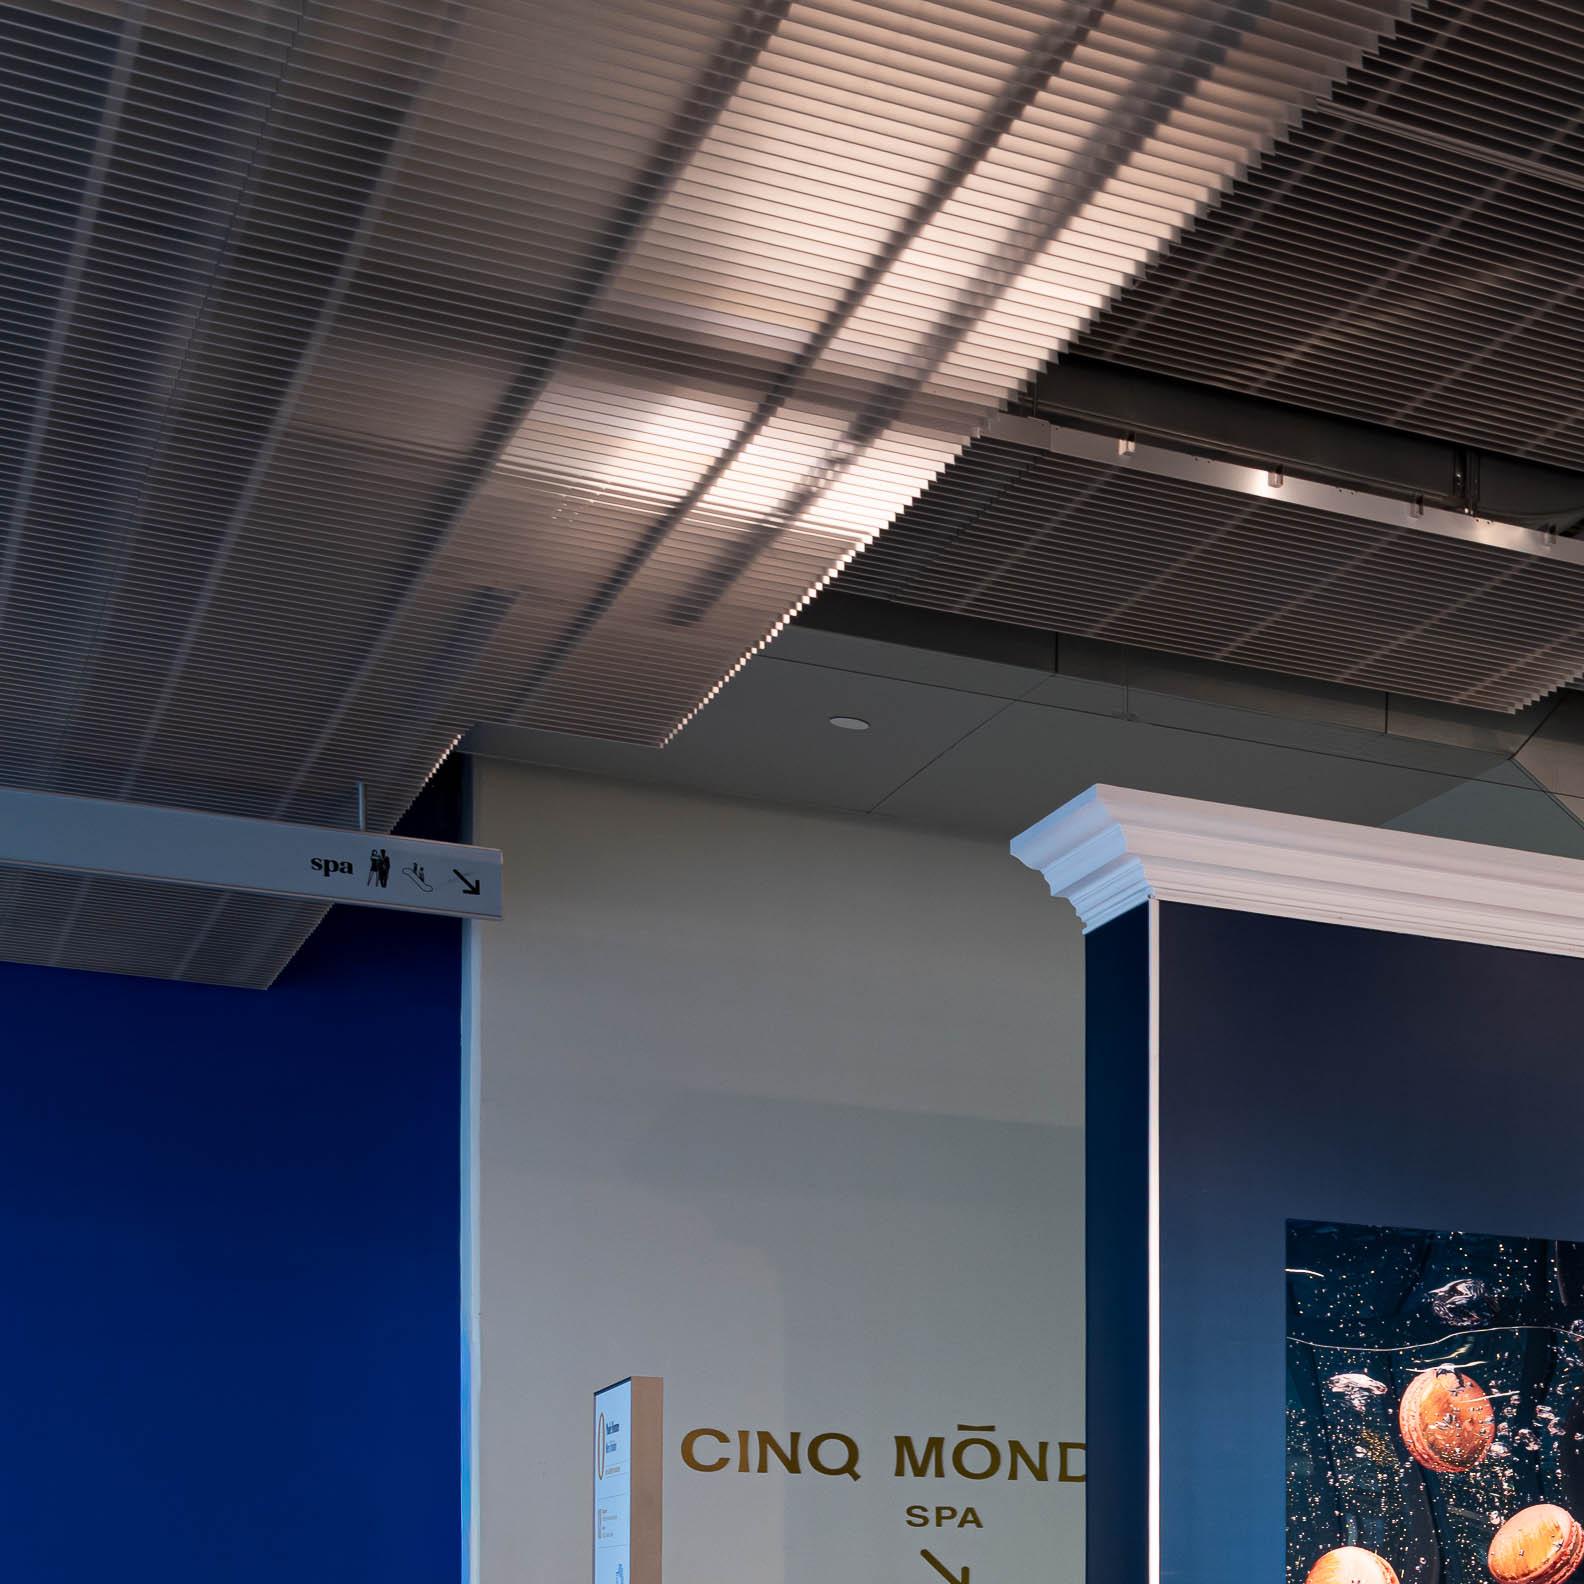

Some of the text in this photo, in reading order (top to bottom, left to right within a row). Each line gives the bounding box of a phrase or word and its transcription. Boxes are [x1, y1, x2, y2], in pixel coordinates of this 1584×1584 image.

[310, 857, 354, 877] spa
[680, 1428, 862, 1482] CINQ
[905, 1504, 984, 1529] SPA
